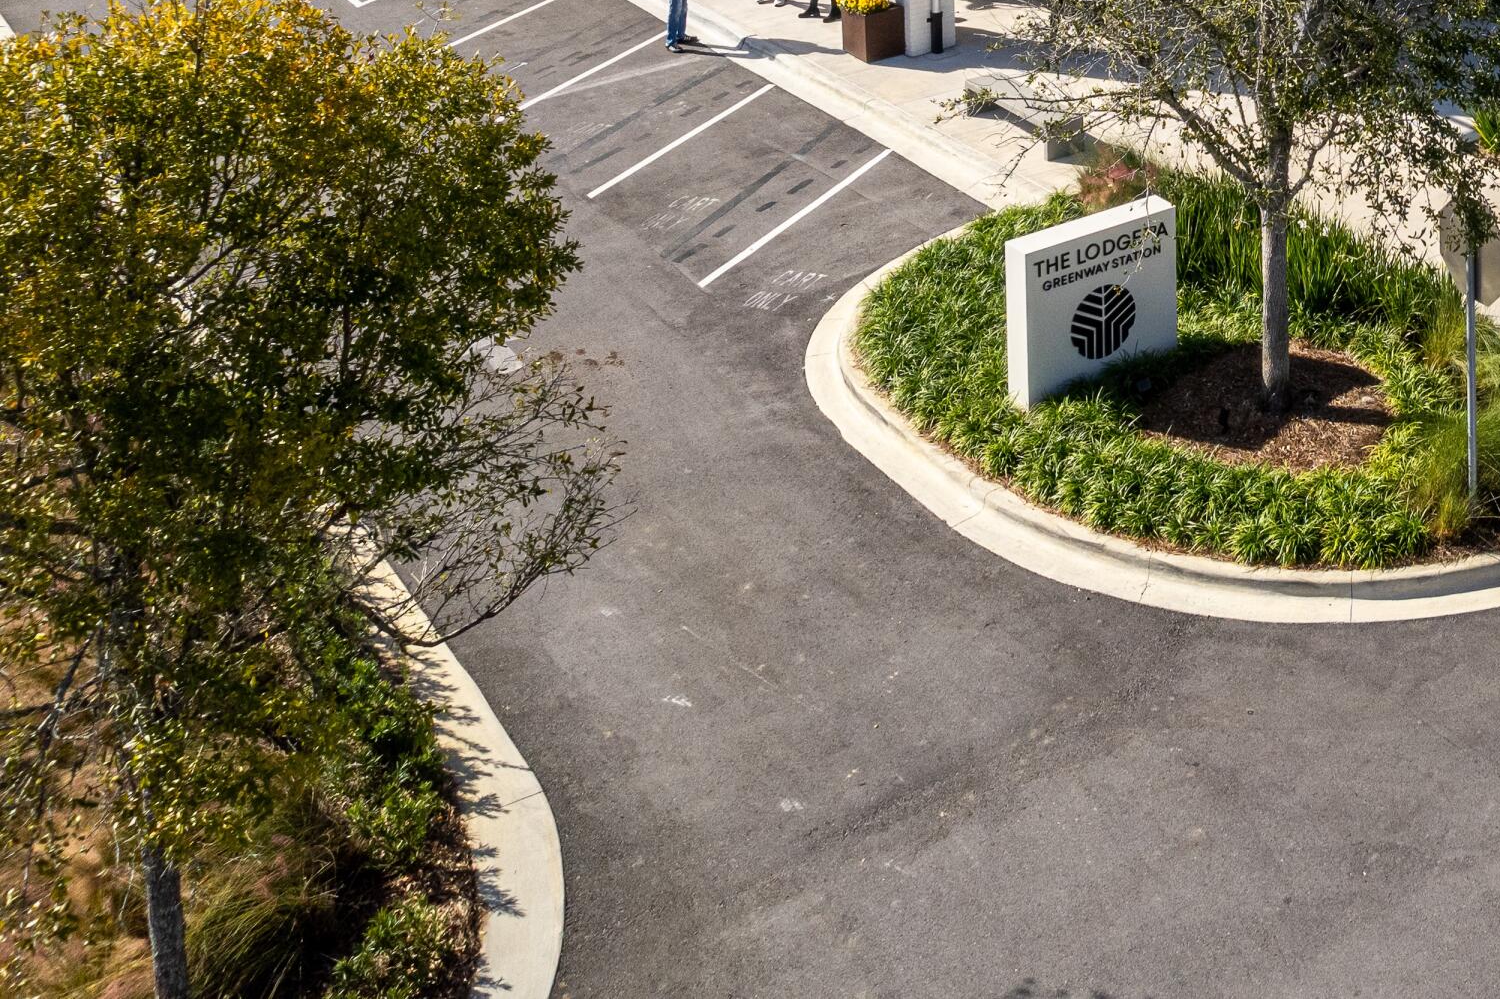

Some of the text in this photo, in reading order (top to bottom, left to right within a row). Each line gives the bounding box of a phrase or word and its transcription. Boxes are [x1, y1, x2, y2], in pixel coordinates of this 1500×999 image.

[1033, 252, 1071, 278] THE
[1076, 229, 1142, 265] LODGE
[771, 270, 829, 291] CART
[1042, 260, 1110, 291] GREENWAY
[743, 290, 799, 312] ONLY
